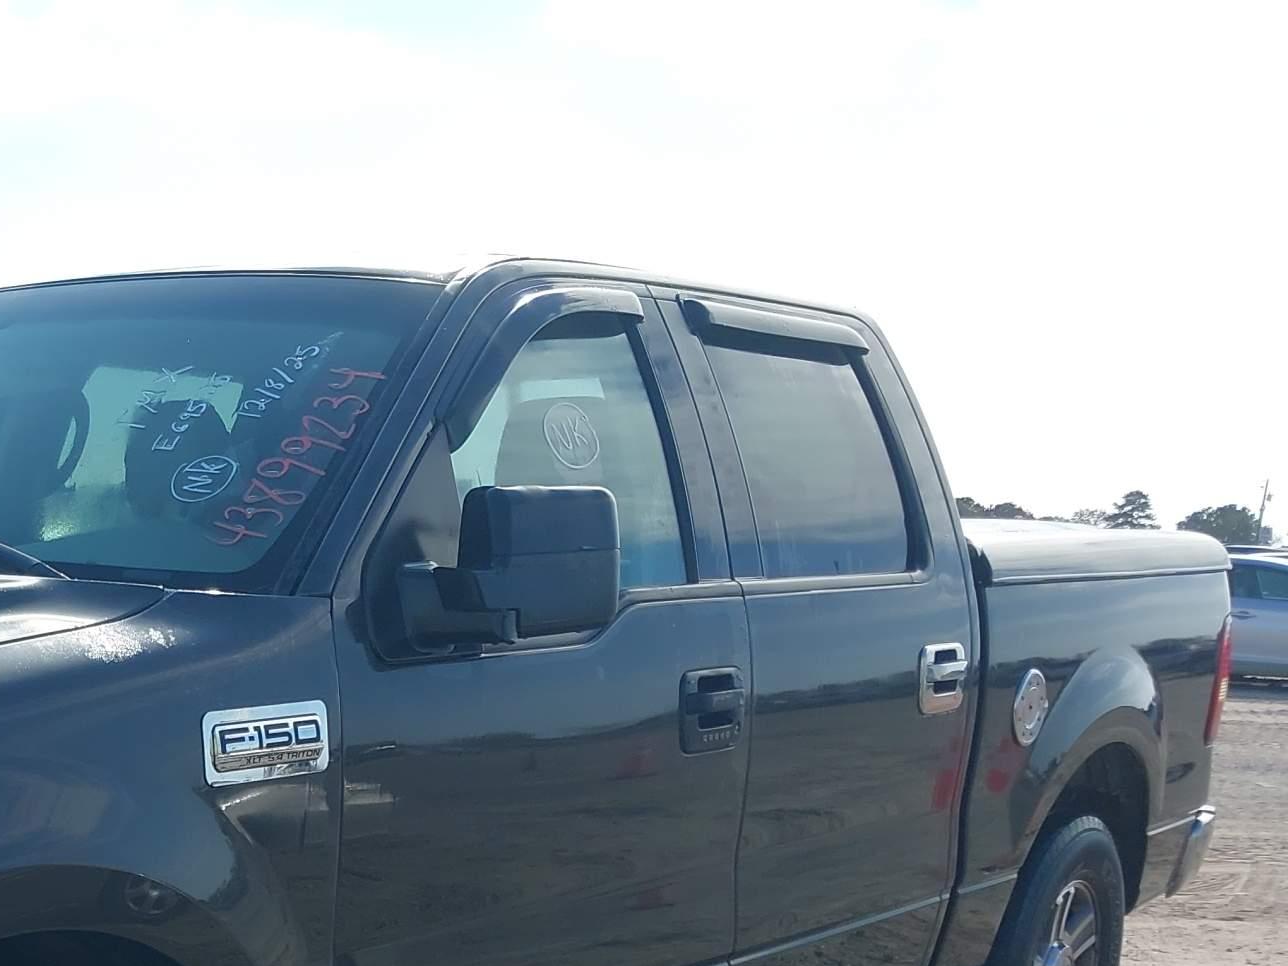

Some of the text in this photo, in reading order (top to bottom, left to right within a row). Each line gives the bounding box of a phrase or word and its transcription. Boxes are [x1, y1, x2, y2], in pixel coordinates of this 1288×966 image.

[551, 416, 589, 450] NK
[207, 366, 387, 546] 43899234
[182, 461, 229, 494] NK
[218, 719, 321, 754] F-150
[245, 755, 264, 765] XLT
[286, 748, 320, 760] TRITON
